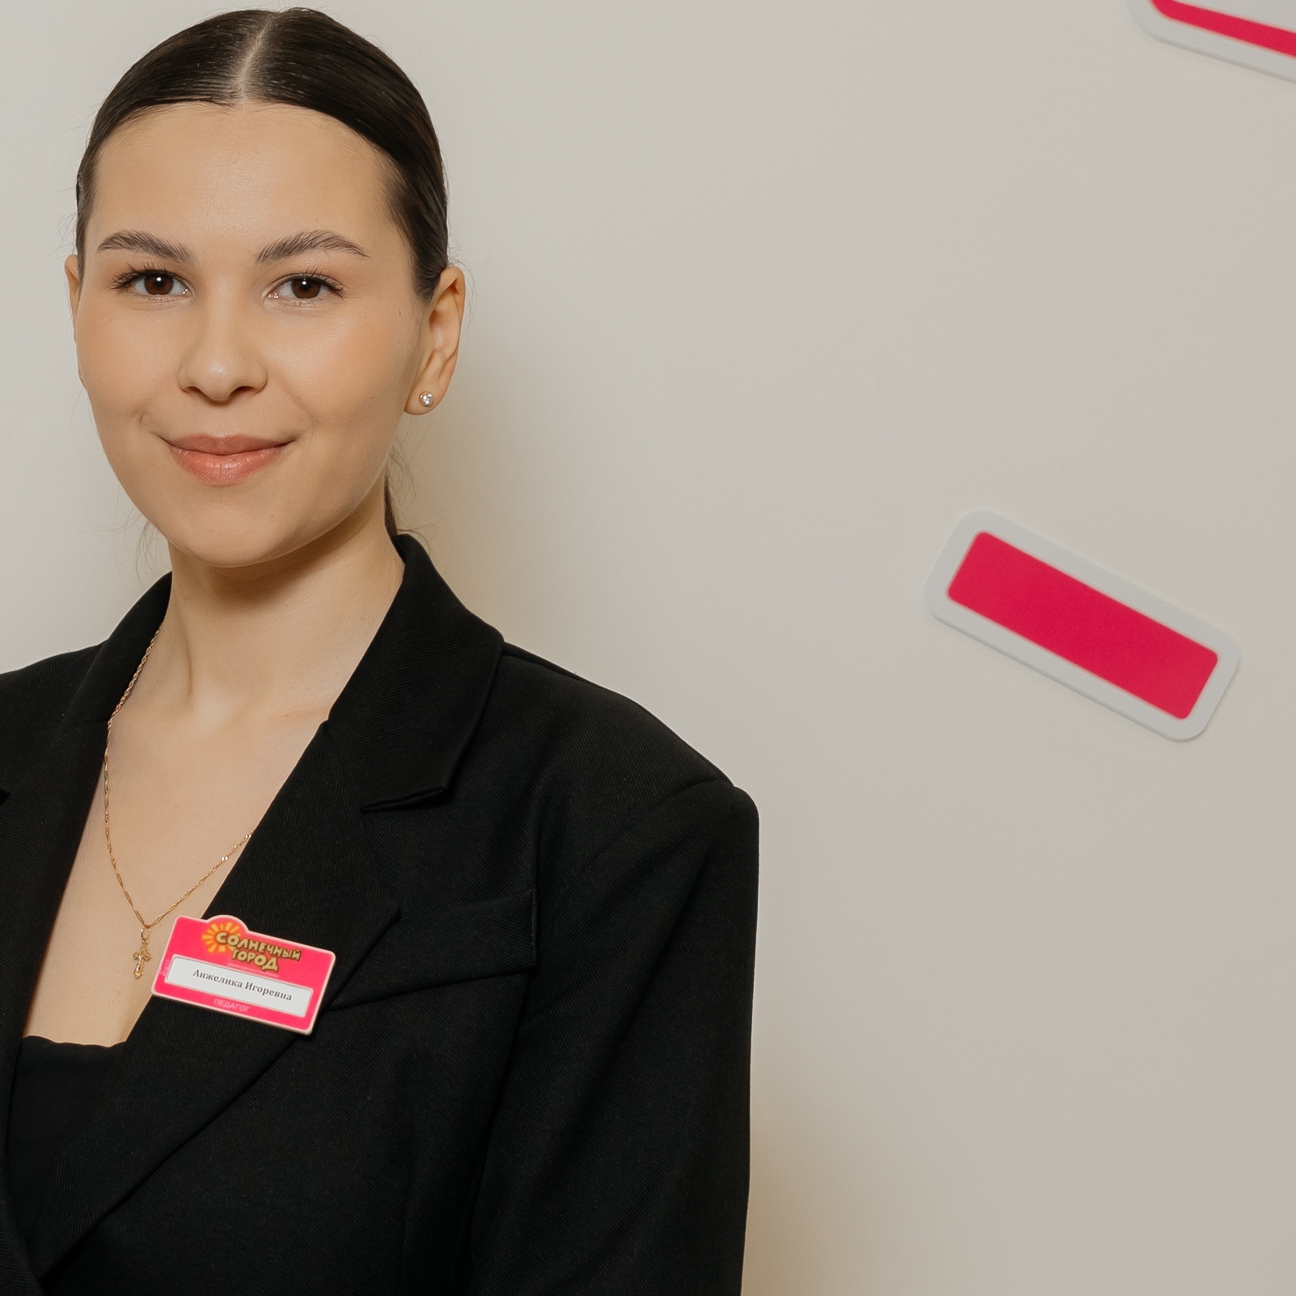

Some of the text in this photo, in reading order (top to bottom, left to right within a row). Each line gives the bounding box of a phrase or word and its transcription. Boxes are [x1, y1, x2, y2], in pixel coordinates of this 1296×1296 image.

[216, 932, 301, 960] СОЛНЕЧНЫЙ
[232, 949, 278, 972] ГОРОД
[193, 969, 243, 988] Анжелика
[245, 981, 292, 1001] Игоревна
[213, 998, 250, 1012] ПЕДАГОГ
